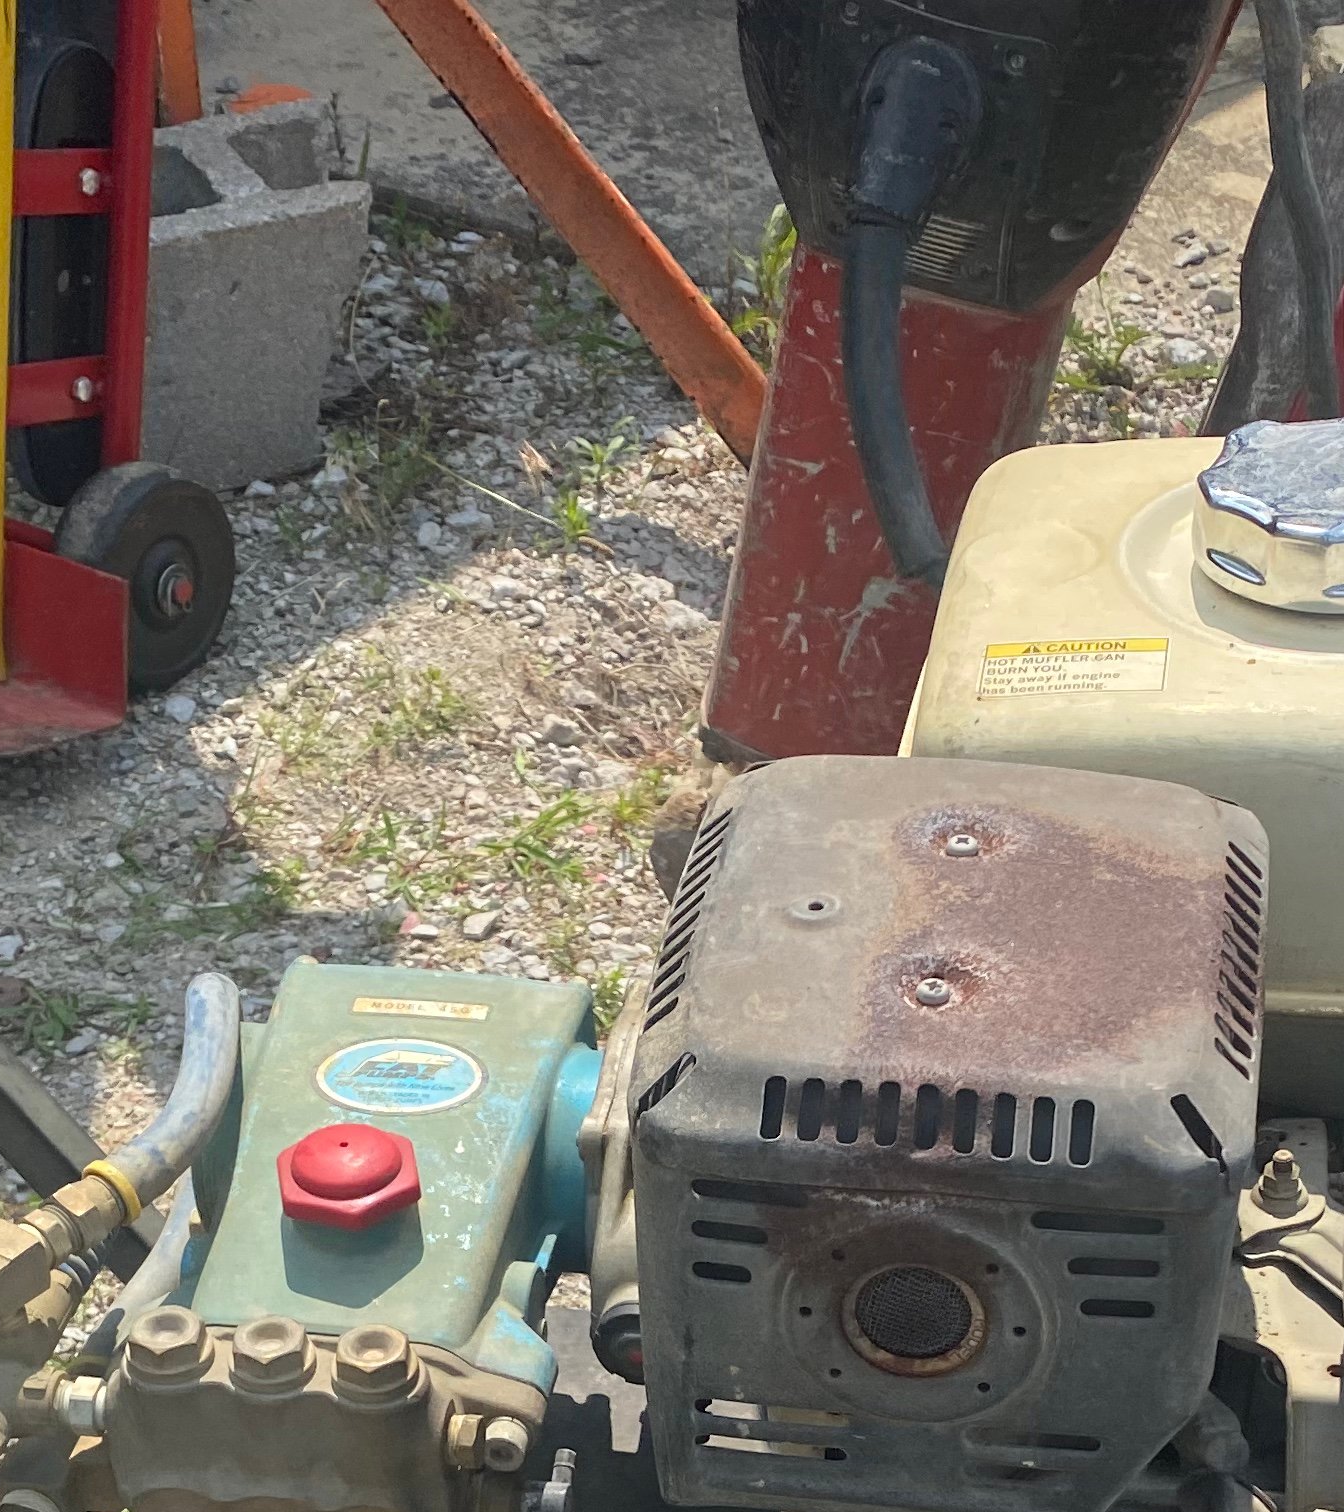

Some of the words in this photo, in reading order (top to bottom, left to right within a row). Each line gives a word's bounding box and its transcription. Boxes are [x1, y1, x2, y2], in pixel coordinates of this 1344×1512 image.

[1046, 641, 1127, 653] CAUTION
[987, 657, 1017, 667] HOT
[1022, 654, 1090, 665] MUFFLER
[1094, 653, 1126, 662] CAN
[986, 665, 1029, 676] BURN
[983, 675, 1014, 686] Stay
[1017, 674, 1053, 685] away
[1057, 672, 1066, 681] if
[1072, 672, 1121, 682] engine
[982, 685, 1007, 695] has
[1010, 684, 1045, 694] been
[1048, 681, 1108, 692] running.
[371, 1001, 427, 1012] MODEL
